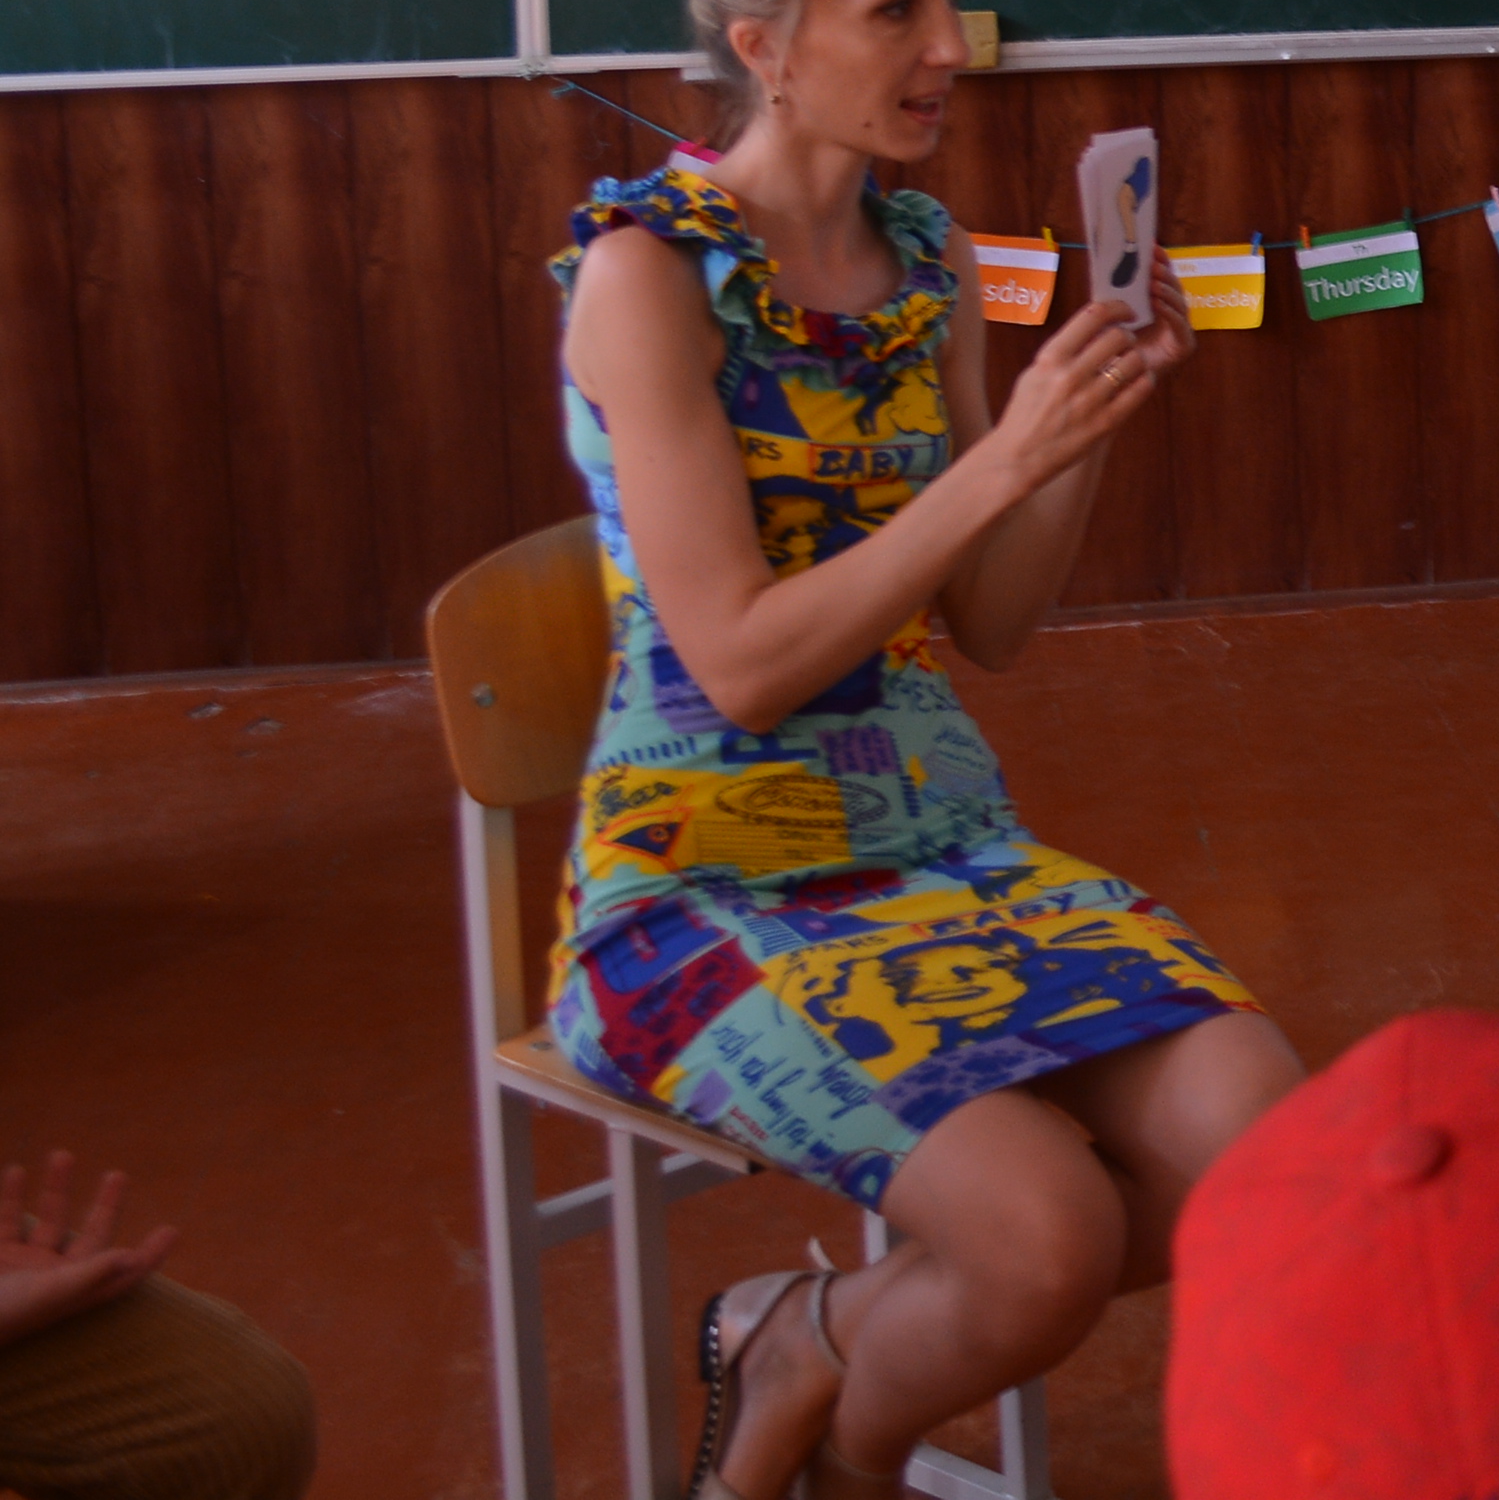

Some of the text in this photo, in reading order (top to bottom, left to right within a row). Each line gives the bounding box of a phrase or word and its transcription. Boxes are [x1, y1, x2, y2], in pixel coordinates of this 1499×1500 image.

[982, 278, 1047, 314] sday
[1184, 287, 1263, 312] nesday
[1304, 265, 1419, 303] Thursday
[813, 446, 914, 478] BABY
[930, 893, 1078, 938] BABY
